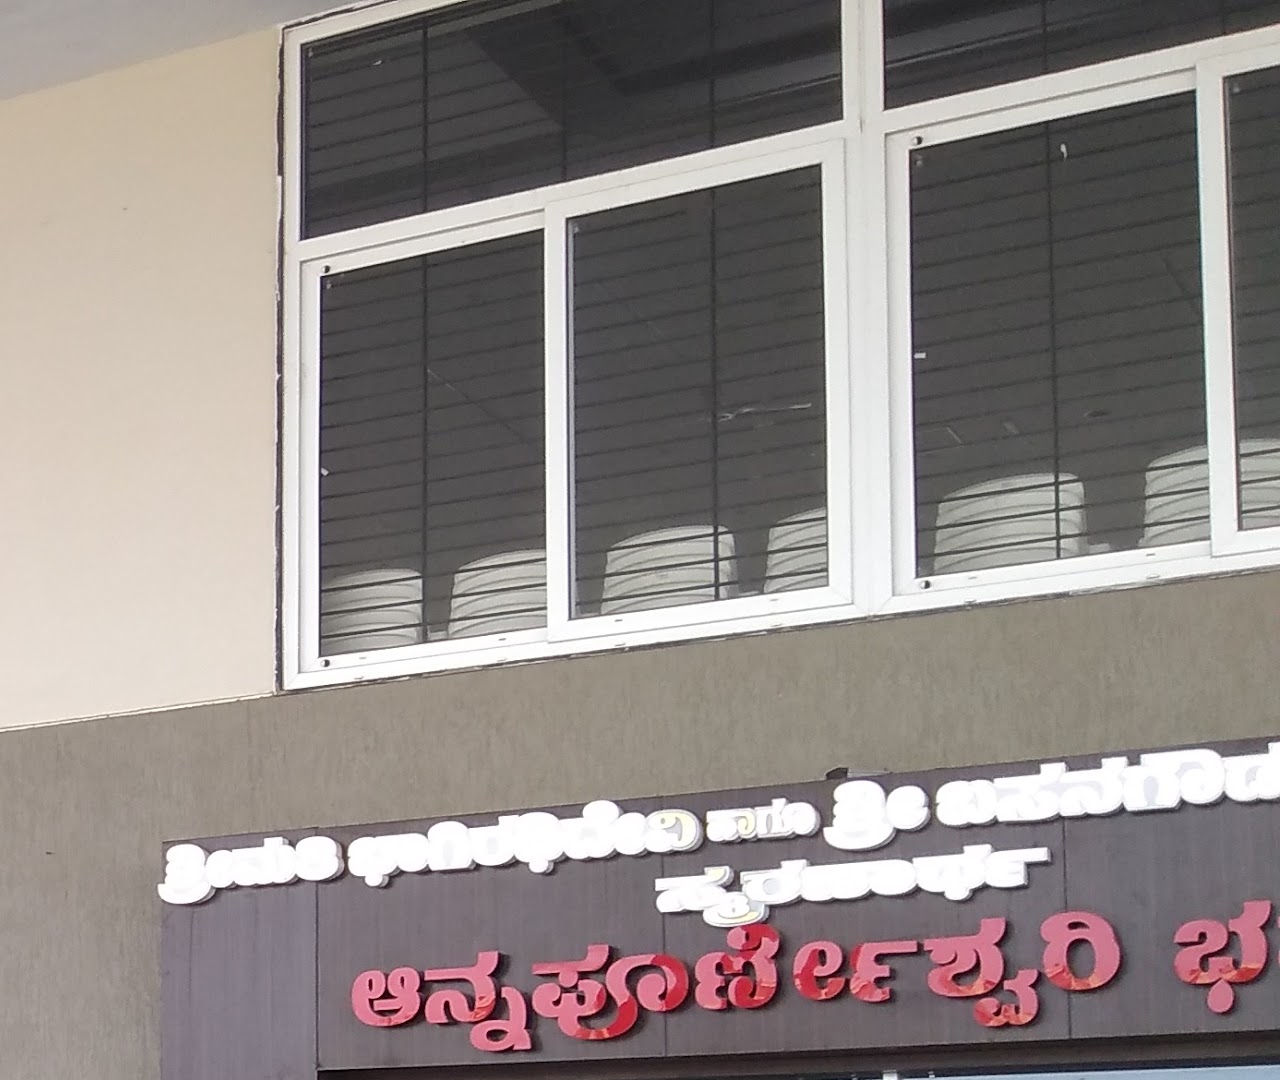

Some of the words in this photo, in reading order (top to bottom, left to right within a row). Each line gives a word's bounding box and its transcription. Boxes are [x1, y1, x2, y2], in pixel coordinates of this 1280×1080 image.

[158, 836, 342, 904] ಶ್ರೀಮತಿ
[706, 798, 820, 843] ಹಾಗೂ
[823, 779, 930, 851] ಶ್ರೀ
[1173, 899, 1280, 1013] ಭ
